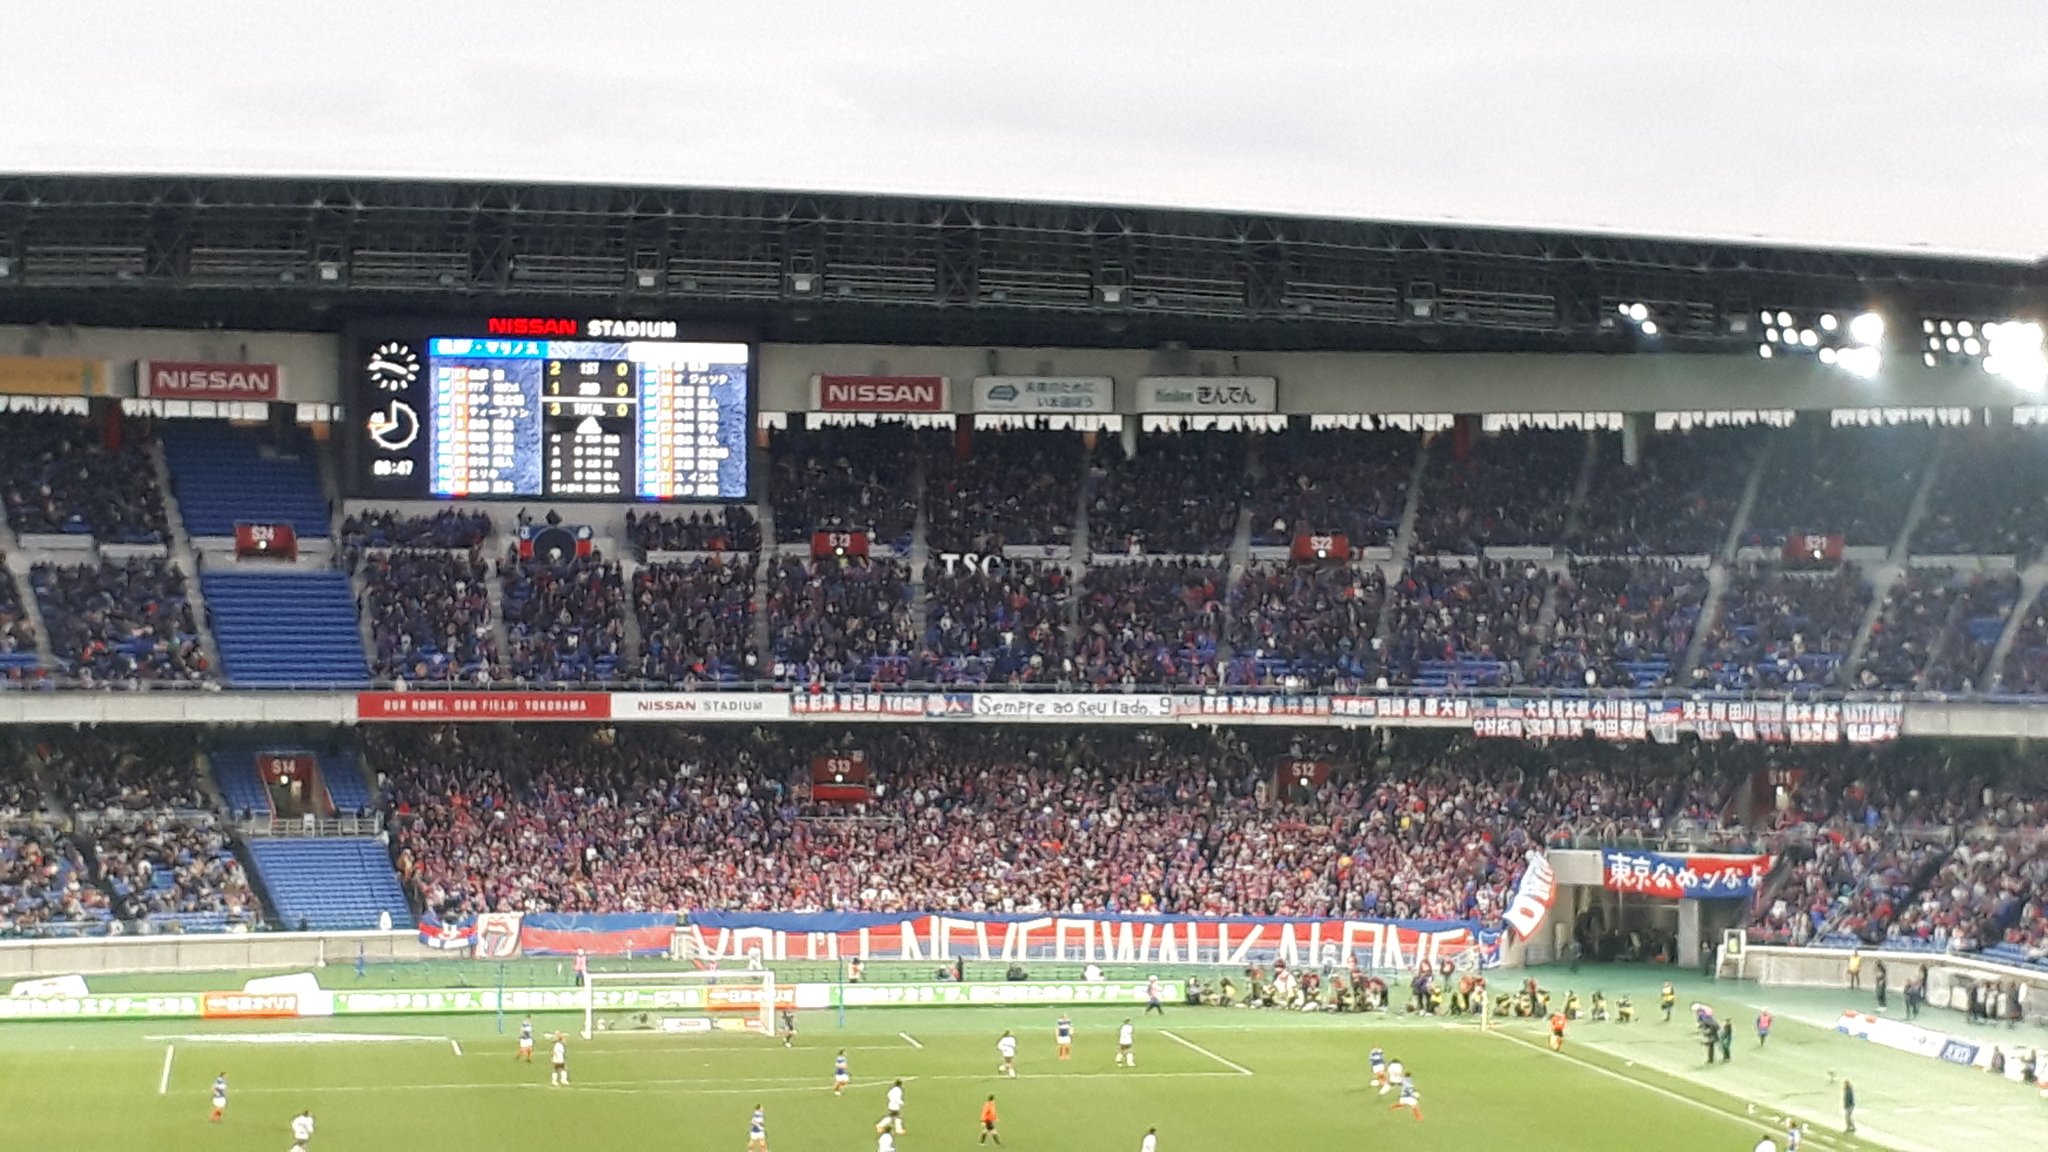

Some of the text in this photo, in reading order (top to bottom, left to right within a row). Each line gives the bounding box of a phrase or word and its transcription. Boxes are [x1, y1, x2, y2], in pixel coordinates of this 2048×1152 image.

[488, 317, 677, 337] NISSAN STADIUM
[549, 361, 561, 376] 2
[616, 362, 628, 377] 0
[158, 370, 269, 391] NISSAN
[551, 381, 560, 395] 1
[616, 382, 628, 397] 0
[828, 383, 935, 402] NISSAN
[1196, 386, 1256, 405] きんでん
[573, 402, 606, 416] TOTAL
[616, 402, 628, 417] 0
[251, 526, 274, 541] S24
[525, 700, 587, 711] YOKOHAMA
[638, 700, 762, 711] NISSAN STADIUM
[979, 695, 1046, 715] Sempre
[271, 759, 296, 774] S14
[827, 759, 850, 773] S13
[1291, 763, 1314, 777] S12
